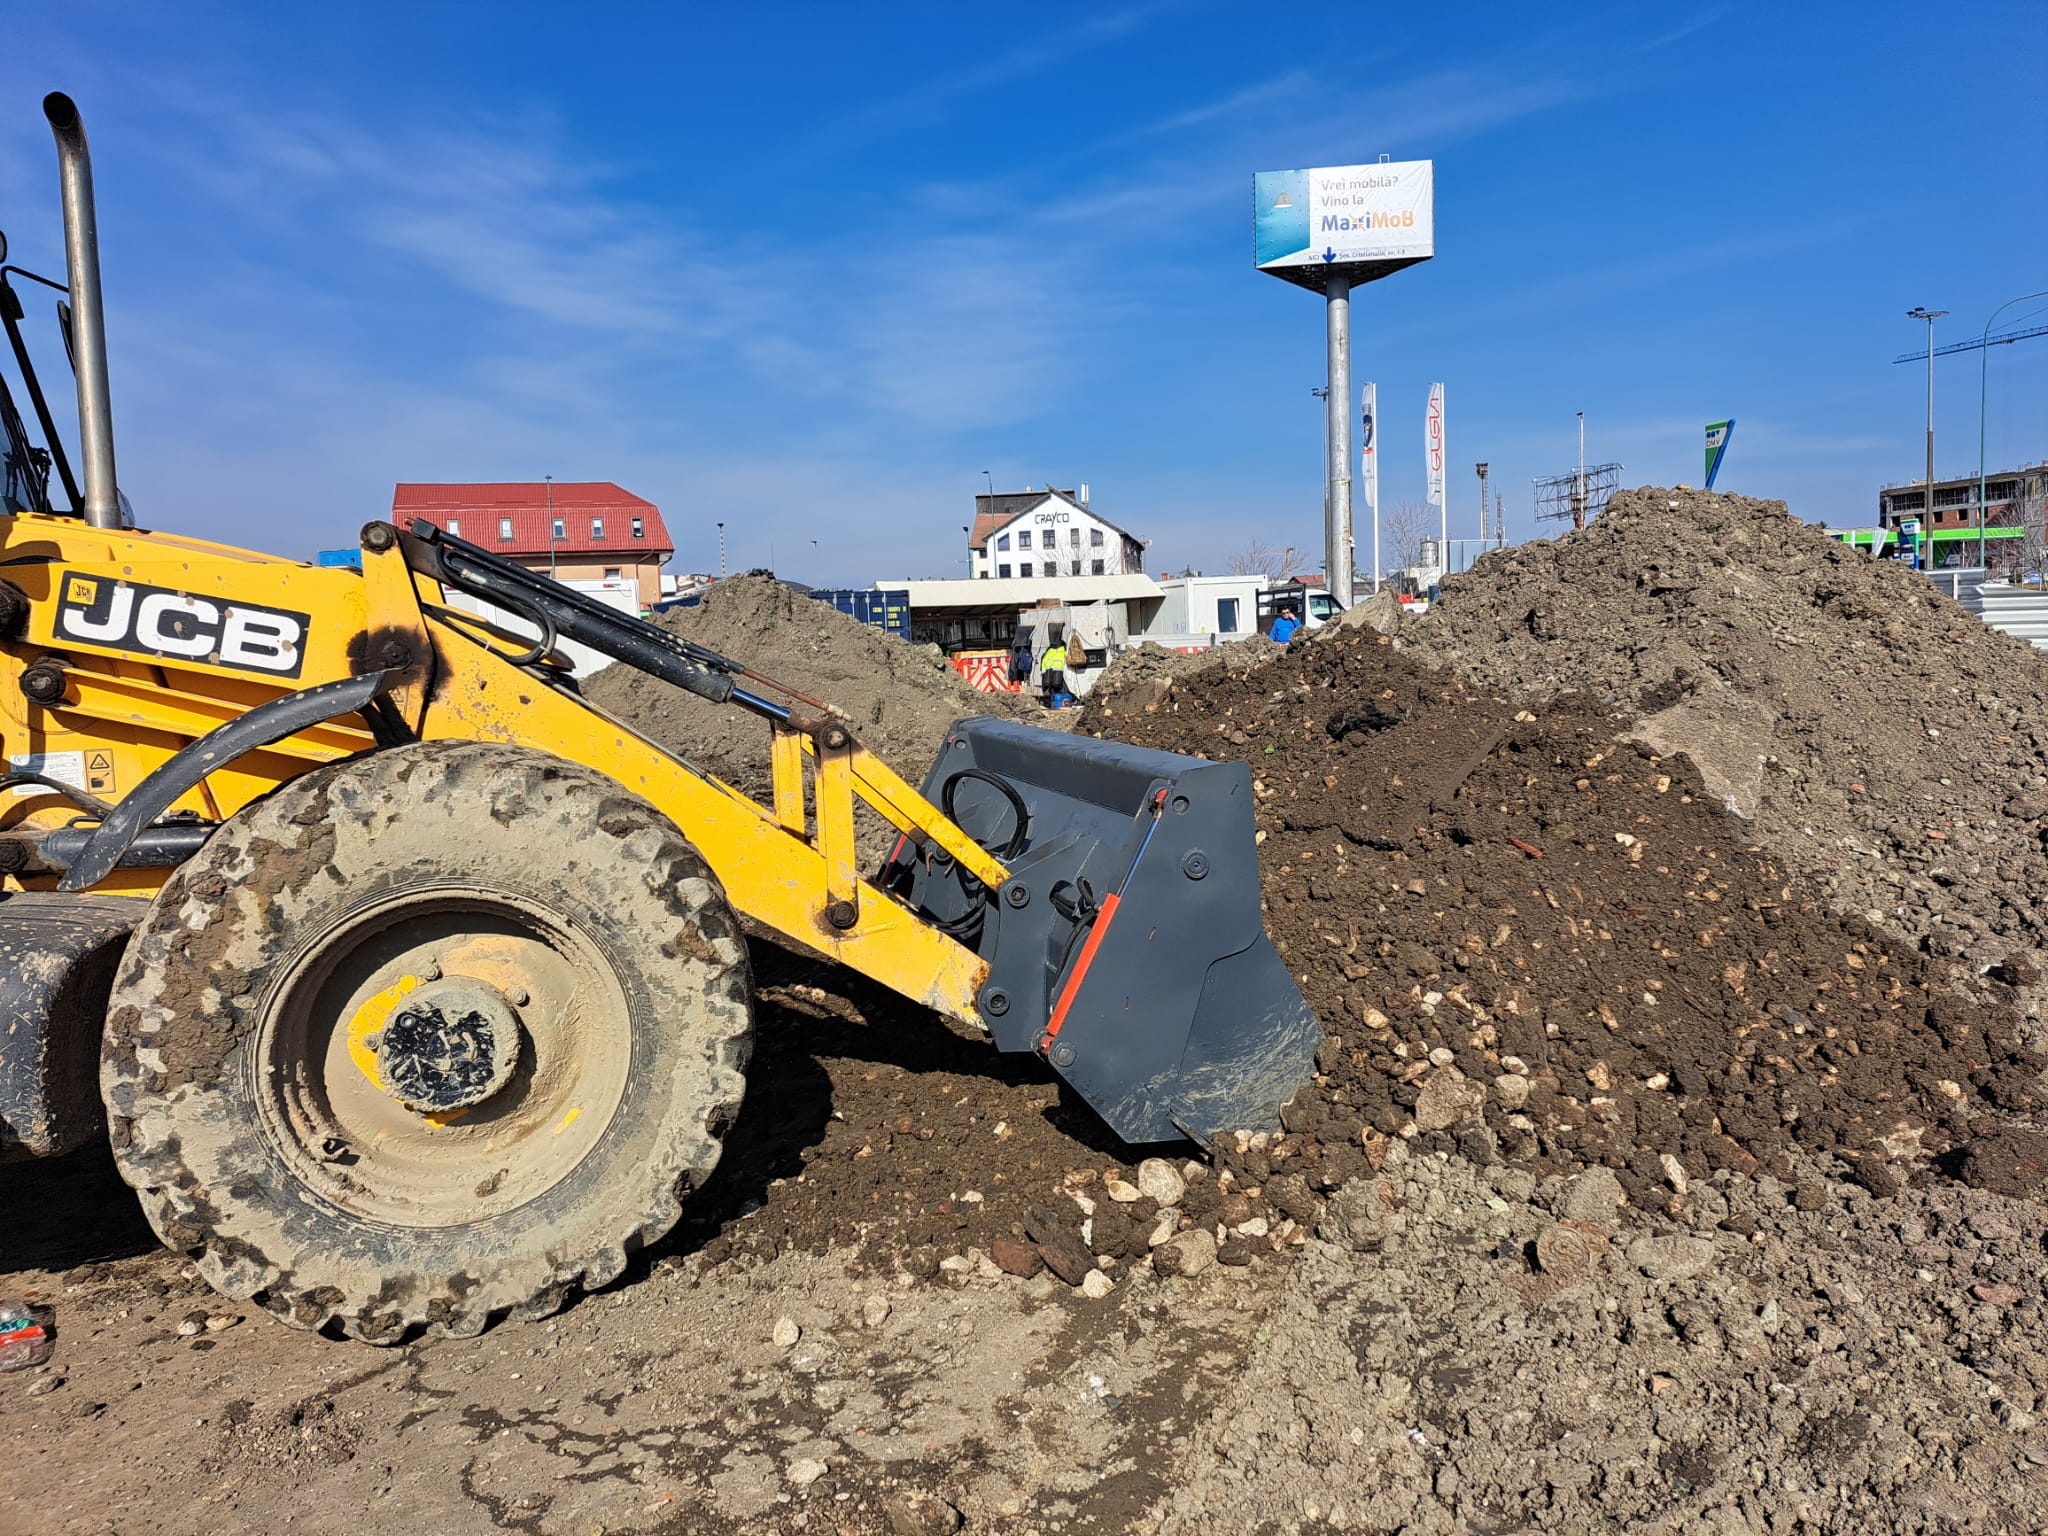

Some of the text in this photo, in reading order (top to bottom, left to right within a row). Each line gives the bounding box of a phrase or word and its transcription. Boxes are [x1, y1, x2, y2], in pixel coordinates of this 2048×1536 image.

[1321, 176, 1399, 191] Vrei mobilă?
[1321, 194, 1364, 207] Vino la
[1034, 511, 1070, 528] CRAYCO
[63, 585, 301, 672] JCB
